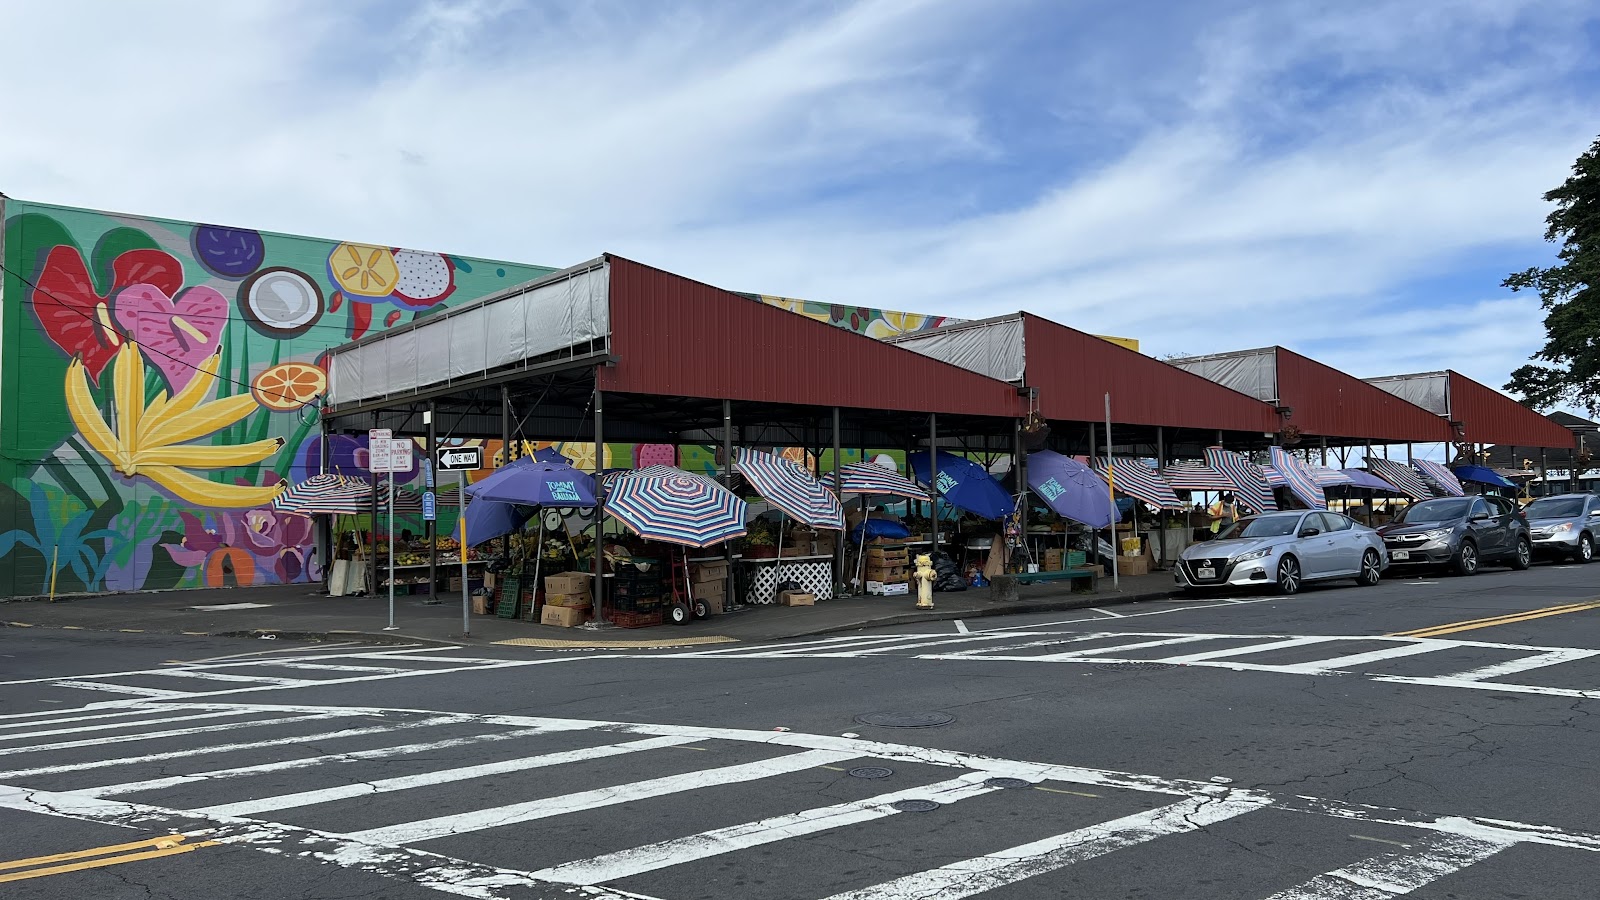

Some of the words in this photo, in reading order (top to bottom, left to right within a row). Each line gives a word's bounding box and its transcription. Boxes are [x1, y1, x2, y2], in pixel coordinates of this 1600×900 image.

[450, 454, 462, 463] ONE
[463, 453, 475, 462] WAY
[935, 470, 959, 488] TOMMY
[545, 481, 576, 492] TOMMY
[1045, 476, 1067, 497] TOMMY
[551, 491, 582, 501] BAHAMA
